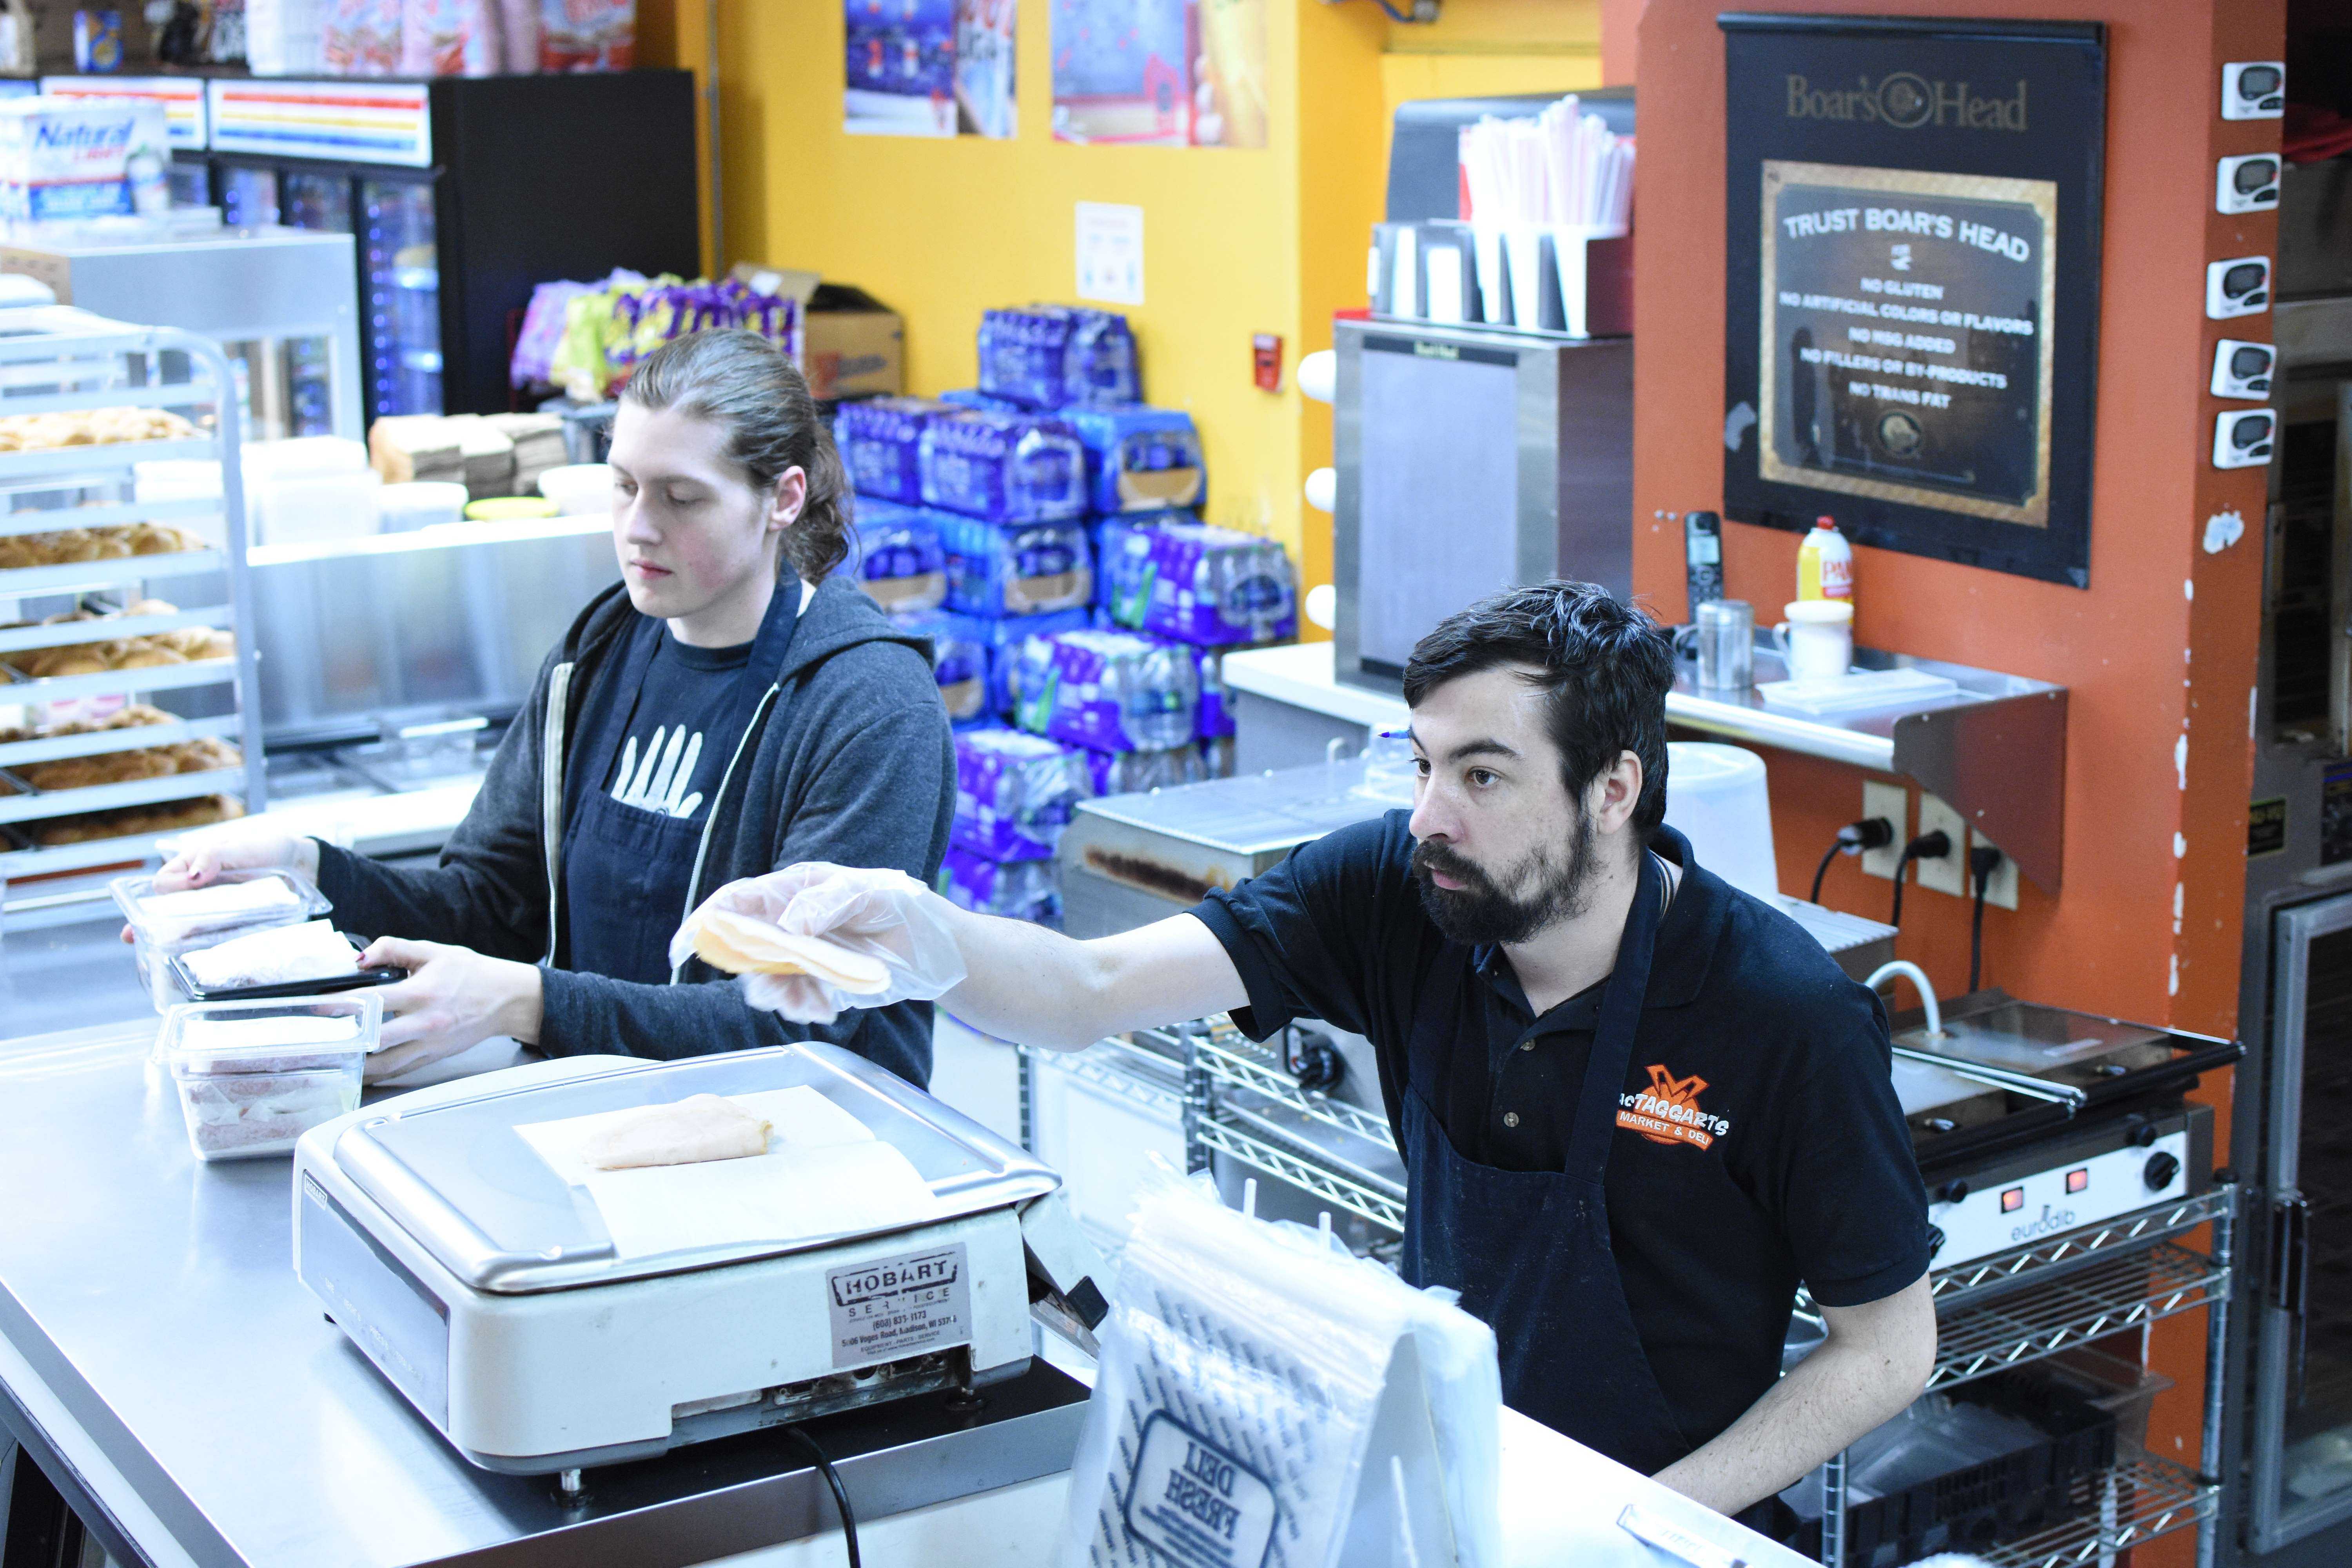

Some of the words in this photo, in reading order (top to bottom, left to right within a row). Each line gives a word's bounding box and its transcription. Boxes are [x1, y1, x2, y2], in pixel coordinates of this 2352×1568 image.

[1787, 74, 1880, 122] Boar's
[1935, 80, 2028, 132] Head
[34, 117, 134, 150] Natural
[1783, 208, 1860, 239] TRUST
[1864, 207, 1953, 239] BOAR'S
[1958, 220, 2030, 262] HEAD
[1860, 277, 1883, 292] NO
[1884, 279, 1944, 299] GLUTEN
[1779, 291, 1801, 307] NO
[1801, 293, 1879, 318] ARTIFICIAL
[1880, 303, 1938, 324] COLORS
[1939, 311, 1962, 327] OR
[1963, 313, 2033, 336] FLAVORS
[1848, 327, 1870, 343] NO
[1904, 334, 1955, 354] ADDED
[1800, 347, 1821, 363] NO
[1823, 350, 1881, 372] FILLERS
[1882, 359, 1904, 375] OR
[1849, 381, 1871, 396] NO
[1871, 383, 1920, 405] TRANS
[1921, 391, 1951, 409] FAT
[1619, 1111, 1670, 1132] MARKET
[1674, 1126, 1682, 1136] &
[1688, 1131, 1710, 1145] DELI
[846, 1260, 947, 1295] HOBART
[849, 1288, 950, 1317] SERICE
